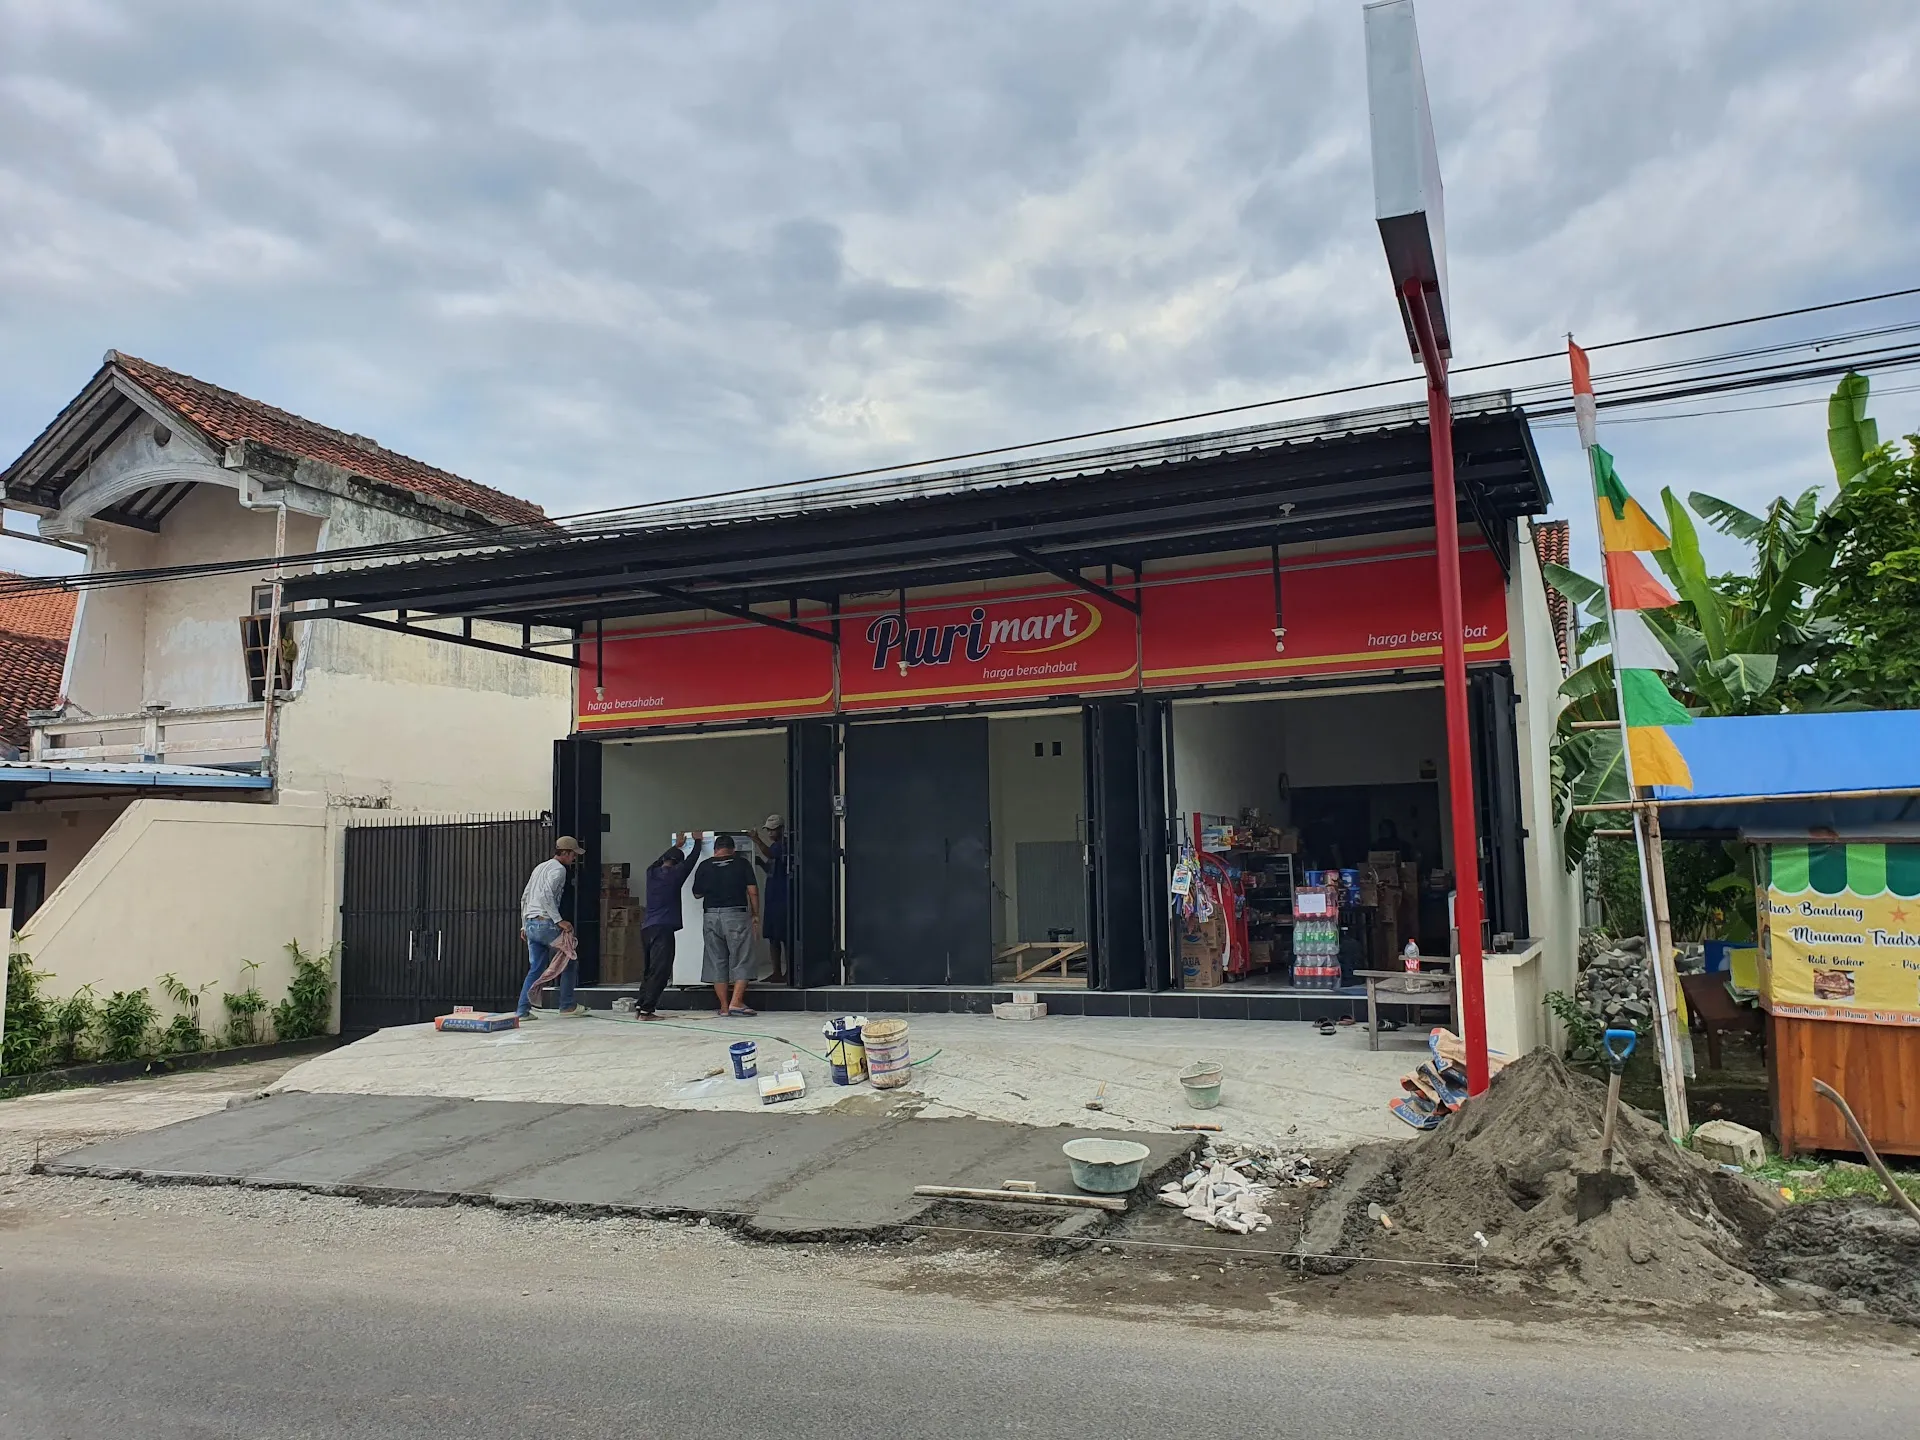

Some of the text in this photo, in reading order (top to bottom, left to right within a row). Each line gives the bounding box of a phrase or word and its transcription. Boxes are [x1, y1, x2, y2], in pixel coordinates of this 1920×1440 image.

[866, 607, 1079, 669] Puri mart
[1367, 624, 1488, 648] harga bersbat
[983, 661, 1078, 680] harga bersahabat
[587, 696, 665, 713] harga bersahabat
[1769, 900, 1863, 922] has Bandung
[1791, 926, 1864, 944] Minuman
[1832, 956, 1864, 966] Bakar
[1902, 1013, 1920, 1022] Cilac
